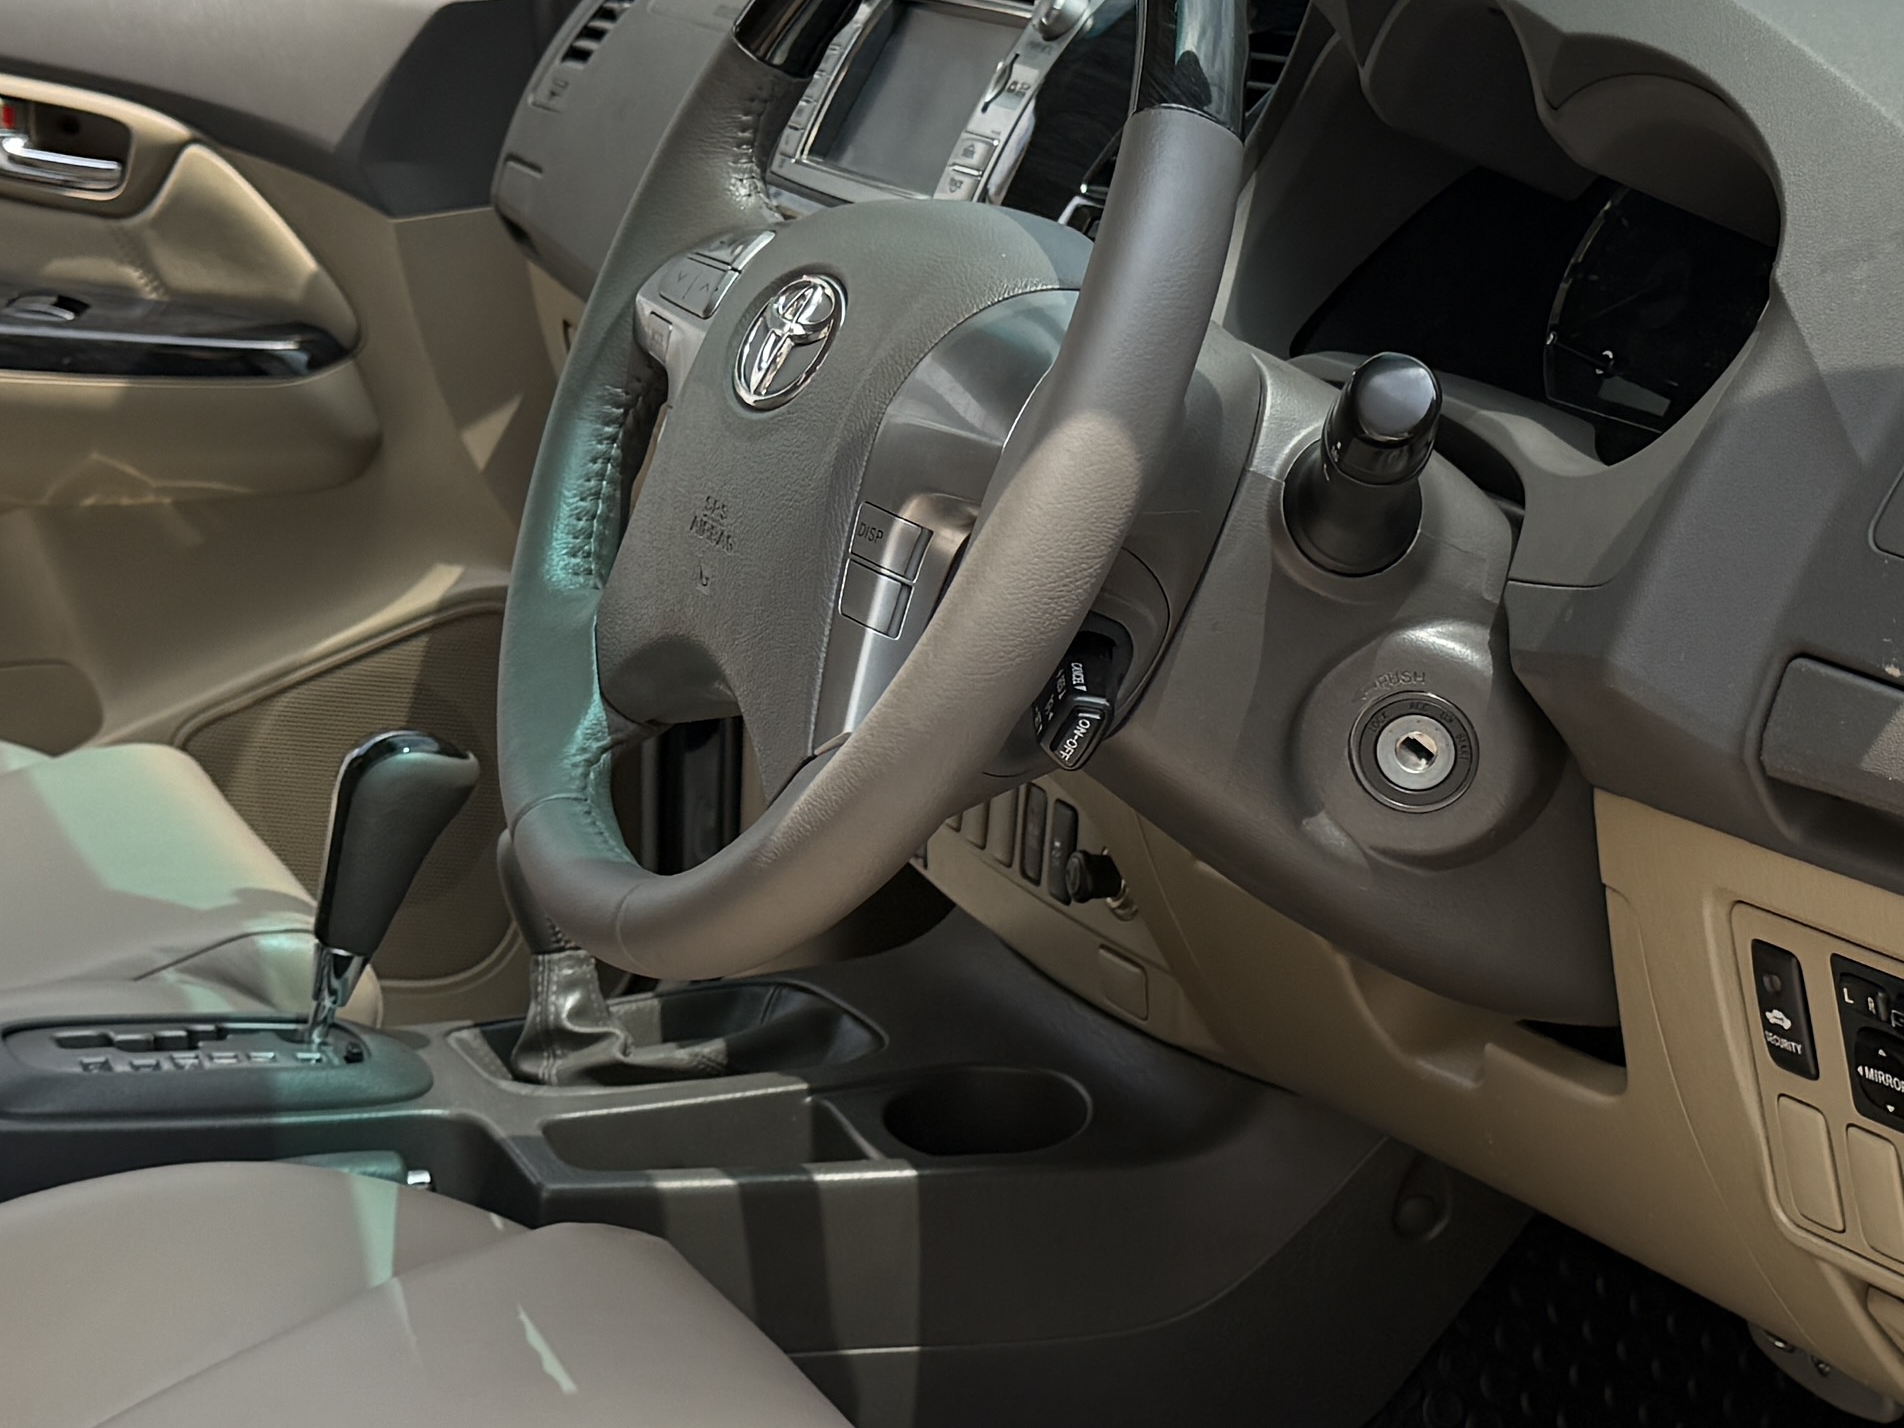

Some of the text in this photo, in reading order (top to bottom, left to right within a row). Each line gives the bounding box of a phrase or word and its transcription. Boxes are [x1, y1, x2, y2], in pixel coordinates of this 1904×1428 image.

[858, 522, 884, 543] DISP
[1377, 671, 1426, 689] PUSH
[1059, 719, 1091, 761] ON-OFF
[1843, 987, 1876, 1014] L R
[1764, 1031, 1802, 1055] SECURITY
